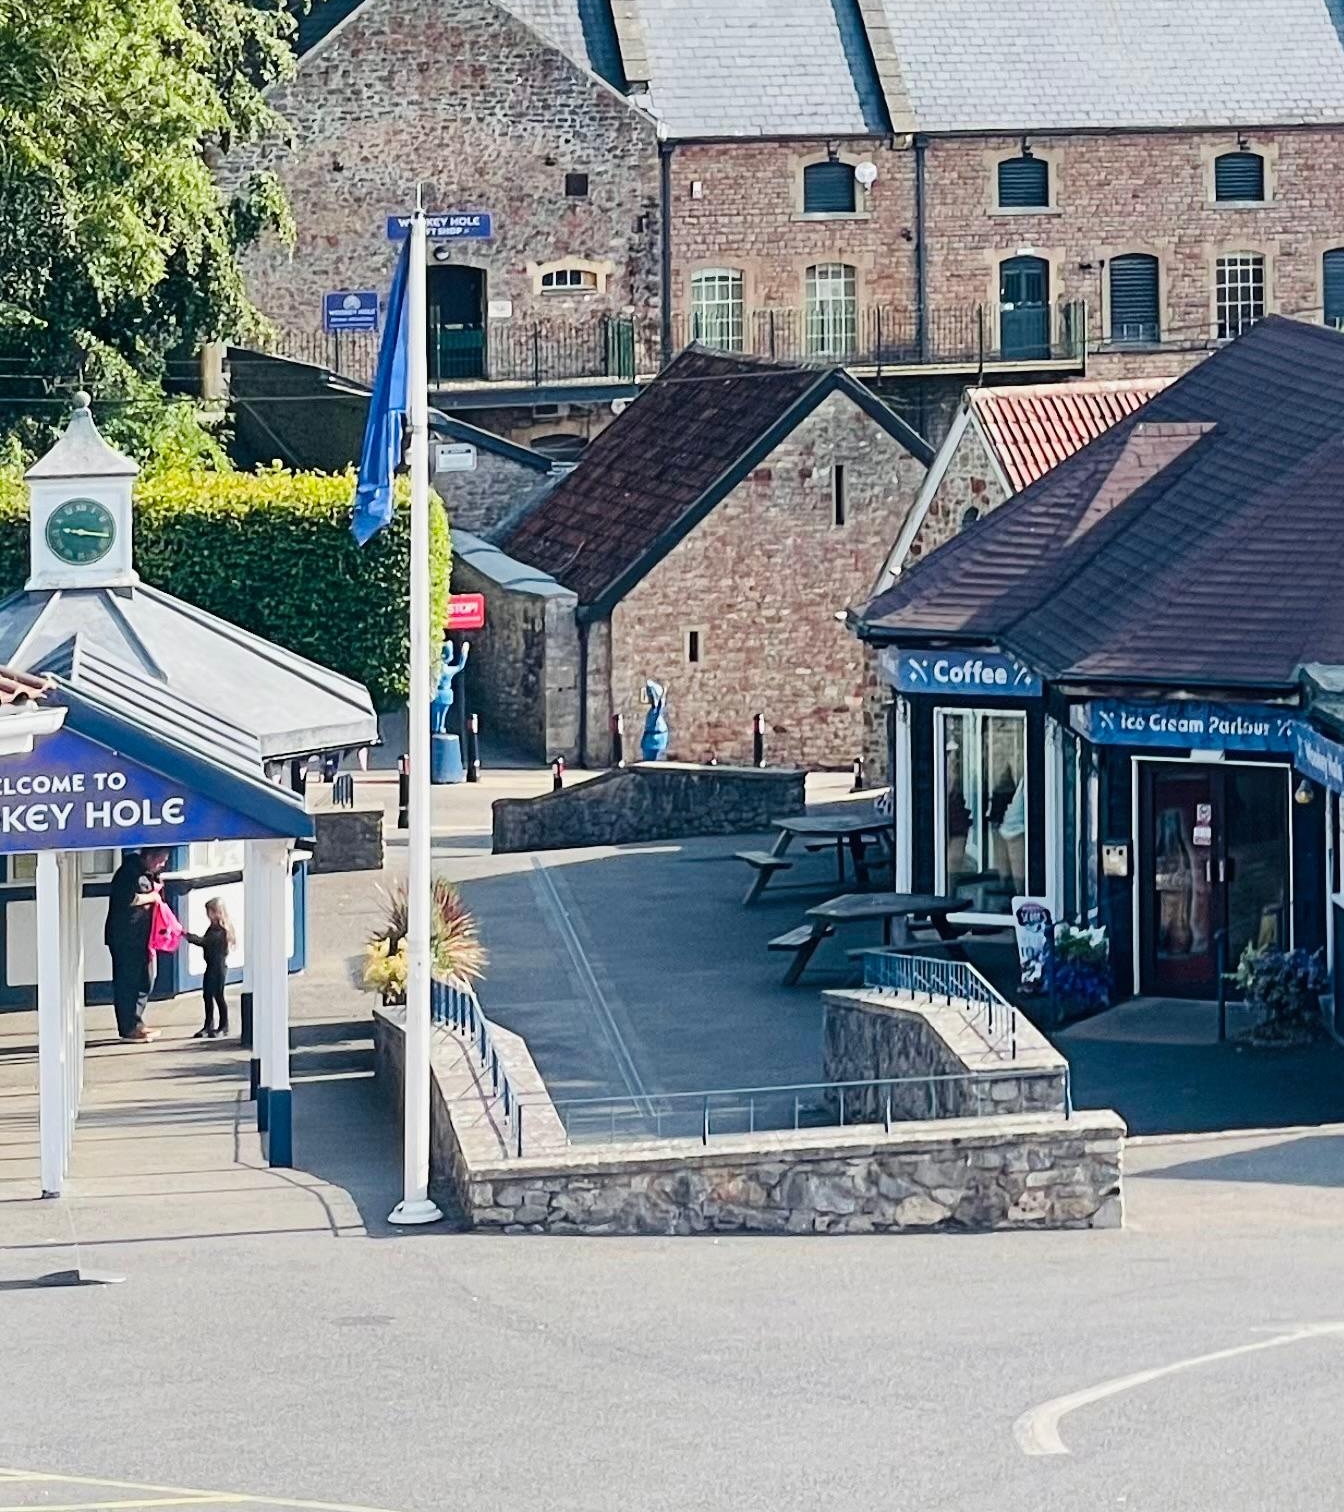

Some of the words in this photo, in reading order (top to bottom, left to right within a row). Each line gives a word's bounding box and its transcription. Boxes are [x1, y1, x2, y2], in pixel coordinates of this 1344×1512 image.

[397, 216, 448, 228] WKEY
[450, 216, 481, 227] HOLE
[933, 659, 1008, 685] Coffee
[1149, 713, 1204, 734] Cream
[1208, 716, 1270, 736] Parlour
[94, 772, 126, 791] TO
[1, 802, 74, 833] KEY
[85, 797, 185, 829] HOLE
